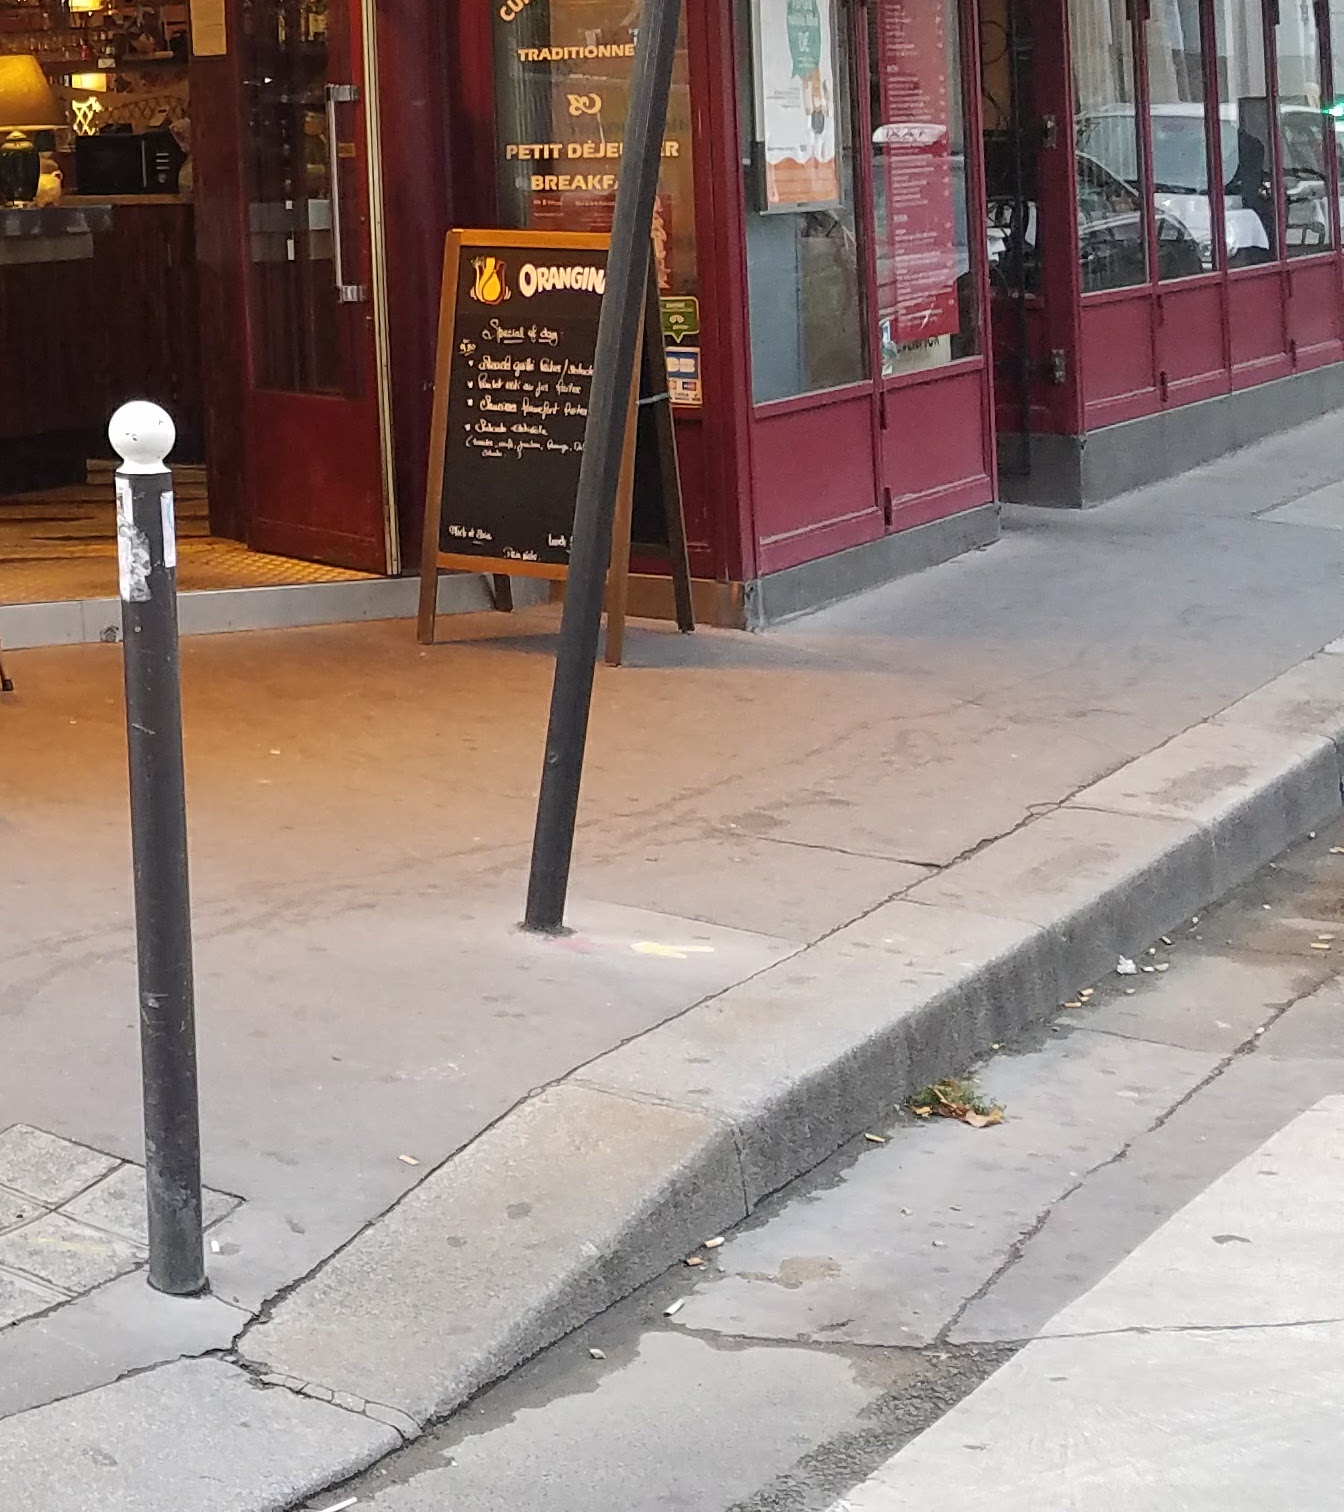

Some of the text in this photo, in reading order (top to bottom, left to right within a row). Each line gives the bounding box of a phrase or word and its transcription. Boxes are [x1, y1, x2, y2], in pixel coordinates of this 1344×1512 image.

[505, 143, 563, 161] PETIT
[530, 174, 619, 191] BREAKF
[518, 262, 606, 299] ORANGIN
